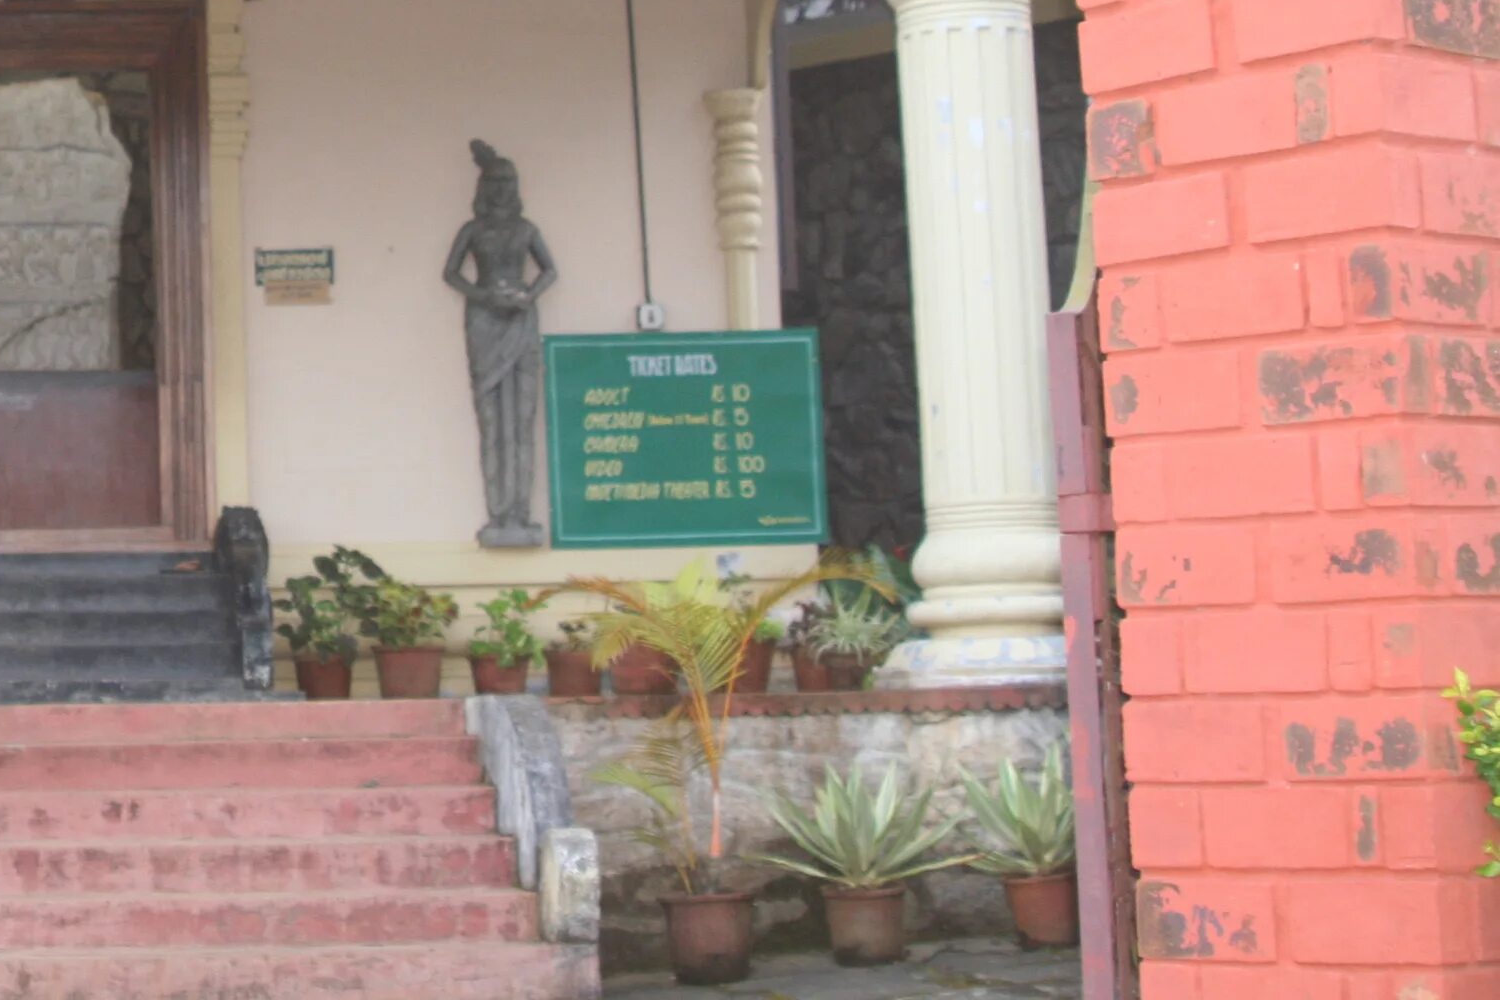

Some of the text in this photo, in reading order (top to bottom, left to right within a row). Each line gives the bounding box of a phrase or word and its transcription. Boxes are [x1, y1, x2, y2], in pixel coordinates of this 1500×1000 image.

[627, 355, 671, 376] TICKET
[732, 383, 750, 402] 10
[733, 406, 749, 426] 5
[735, 431, 754, 450] 10
[738, 455, 765, 474] 100
